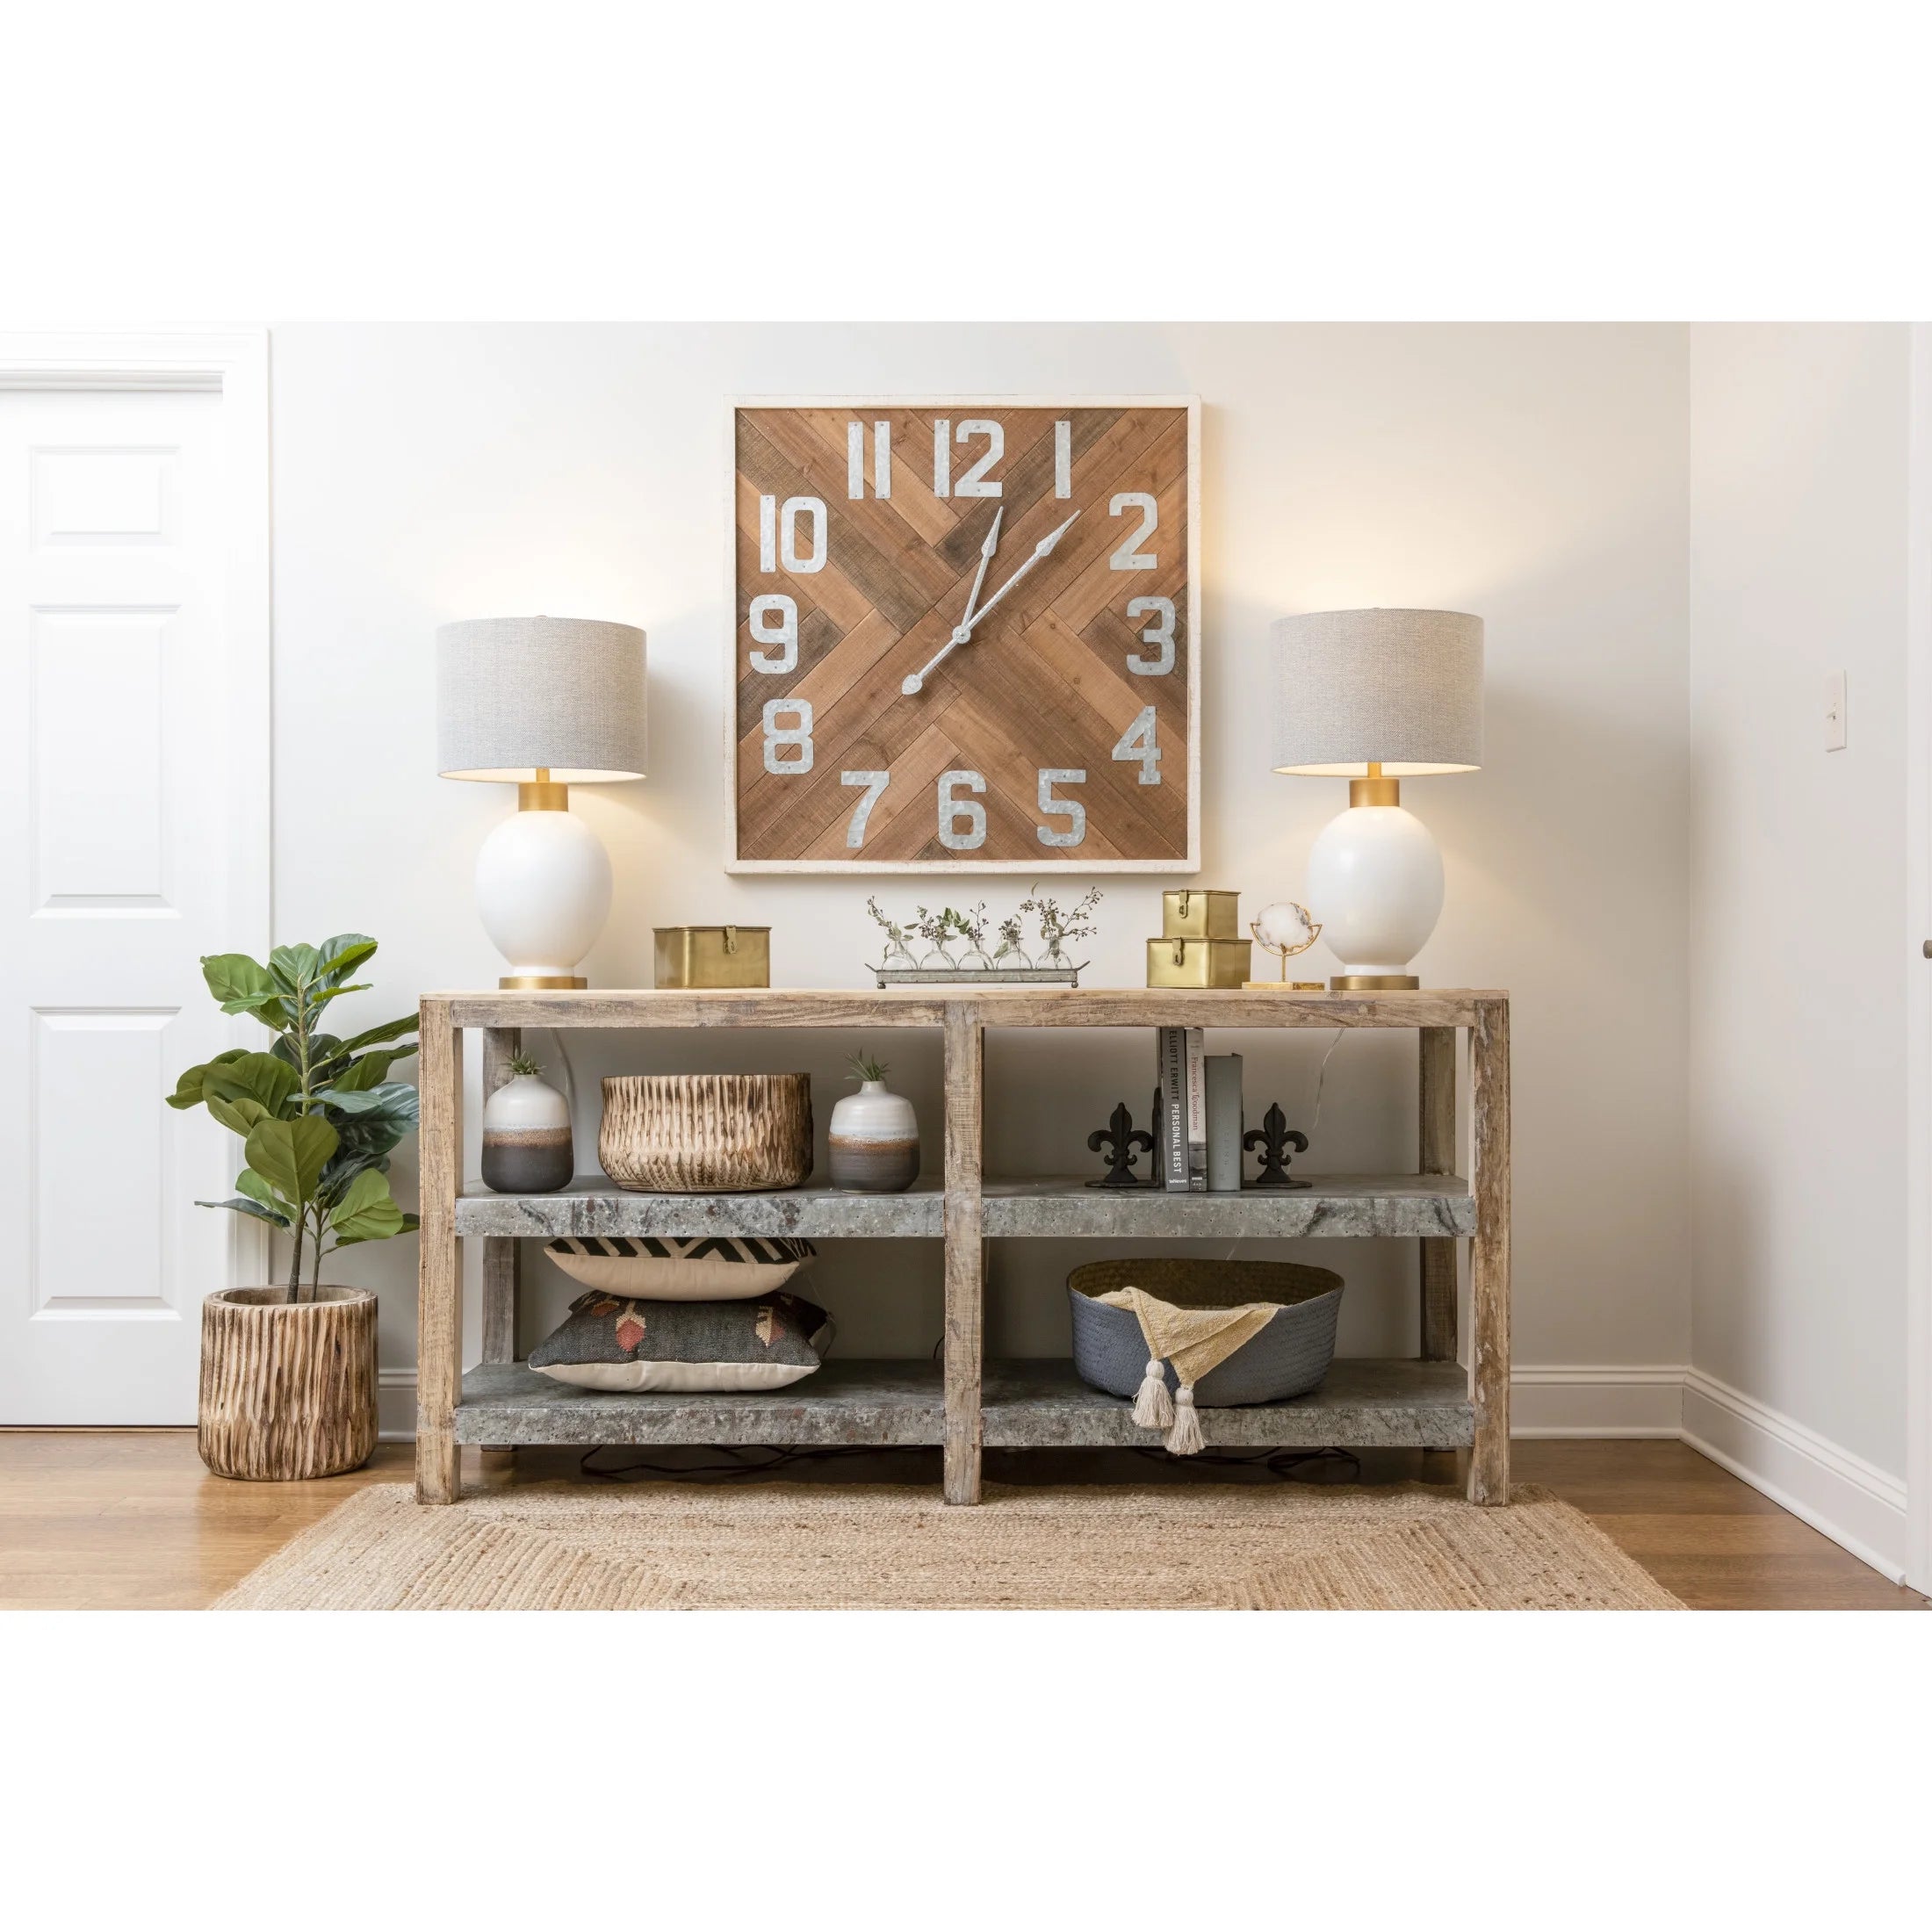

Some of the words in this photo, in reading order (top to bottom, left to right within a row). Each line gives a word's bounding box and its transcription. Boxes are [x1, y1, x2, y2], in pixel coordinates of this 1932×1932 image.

[848, 421, 890, 499] 11
[934, 419, 1005, 497] 12
[1055, 421, 1071, 499] 1
[760, 494, 827, 573] 10
[1108, 493, 1158, 570] 2
[749, 594, 798, 674] 9
[1126, 595, 1176, 675] 3
[762, 698, 814, 775] 8
[1111, 705, 1162, 784] 4
[840, 770, 890, 847] 7
[937, 769, 987, 850] 6
[1036, 768, 1087, 847] 5
[1169, 1030, 1179, 1064] ELLIOTT
[1171, 1067, 1179, 1100] ERWITT
[1171, 1104, 1181, 1149] PERSONAL
[1173, 1151, 1182, 1173] BEST
